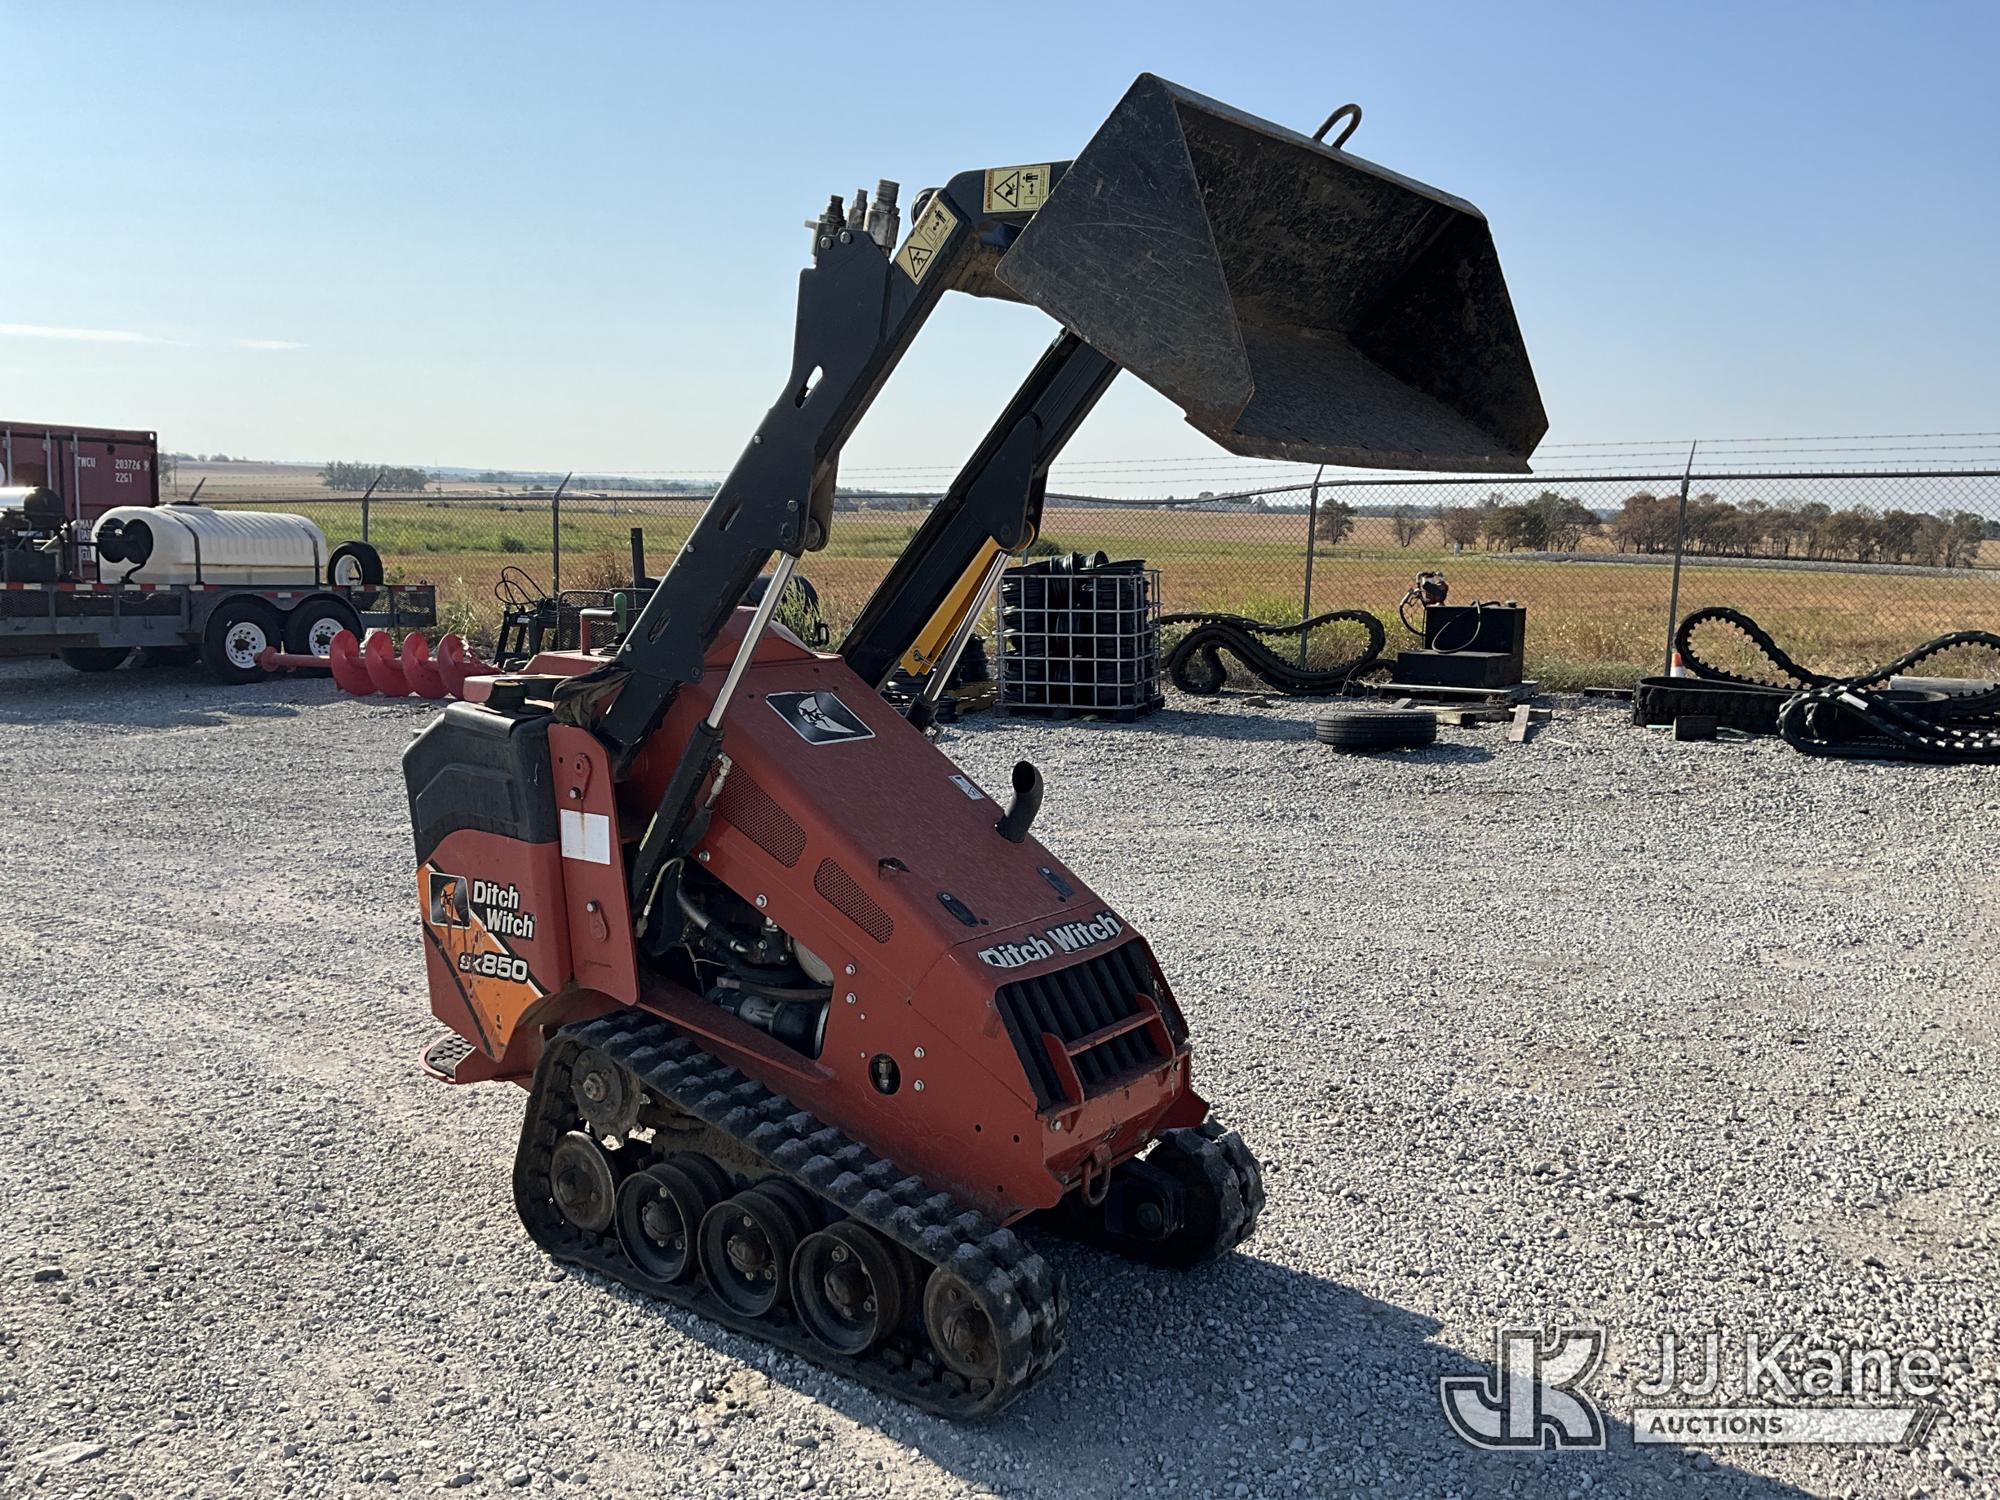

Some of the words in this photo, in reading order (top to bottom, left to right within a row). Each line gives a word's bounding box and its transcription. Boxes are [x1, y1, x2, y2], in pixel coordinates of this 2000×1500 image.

[115, 459, 141, 470] 203726
[473, 881, 519, 909] Ditch
[486, 908, 534, 938] Witch
[980, 936, 1054, 968] Ditch
[1046, 914, 1120, 950] Witch
